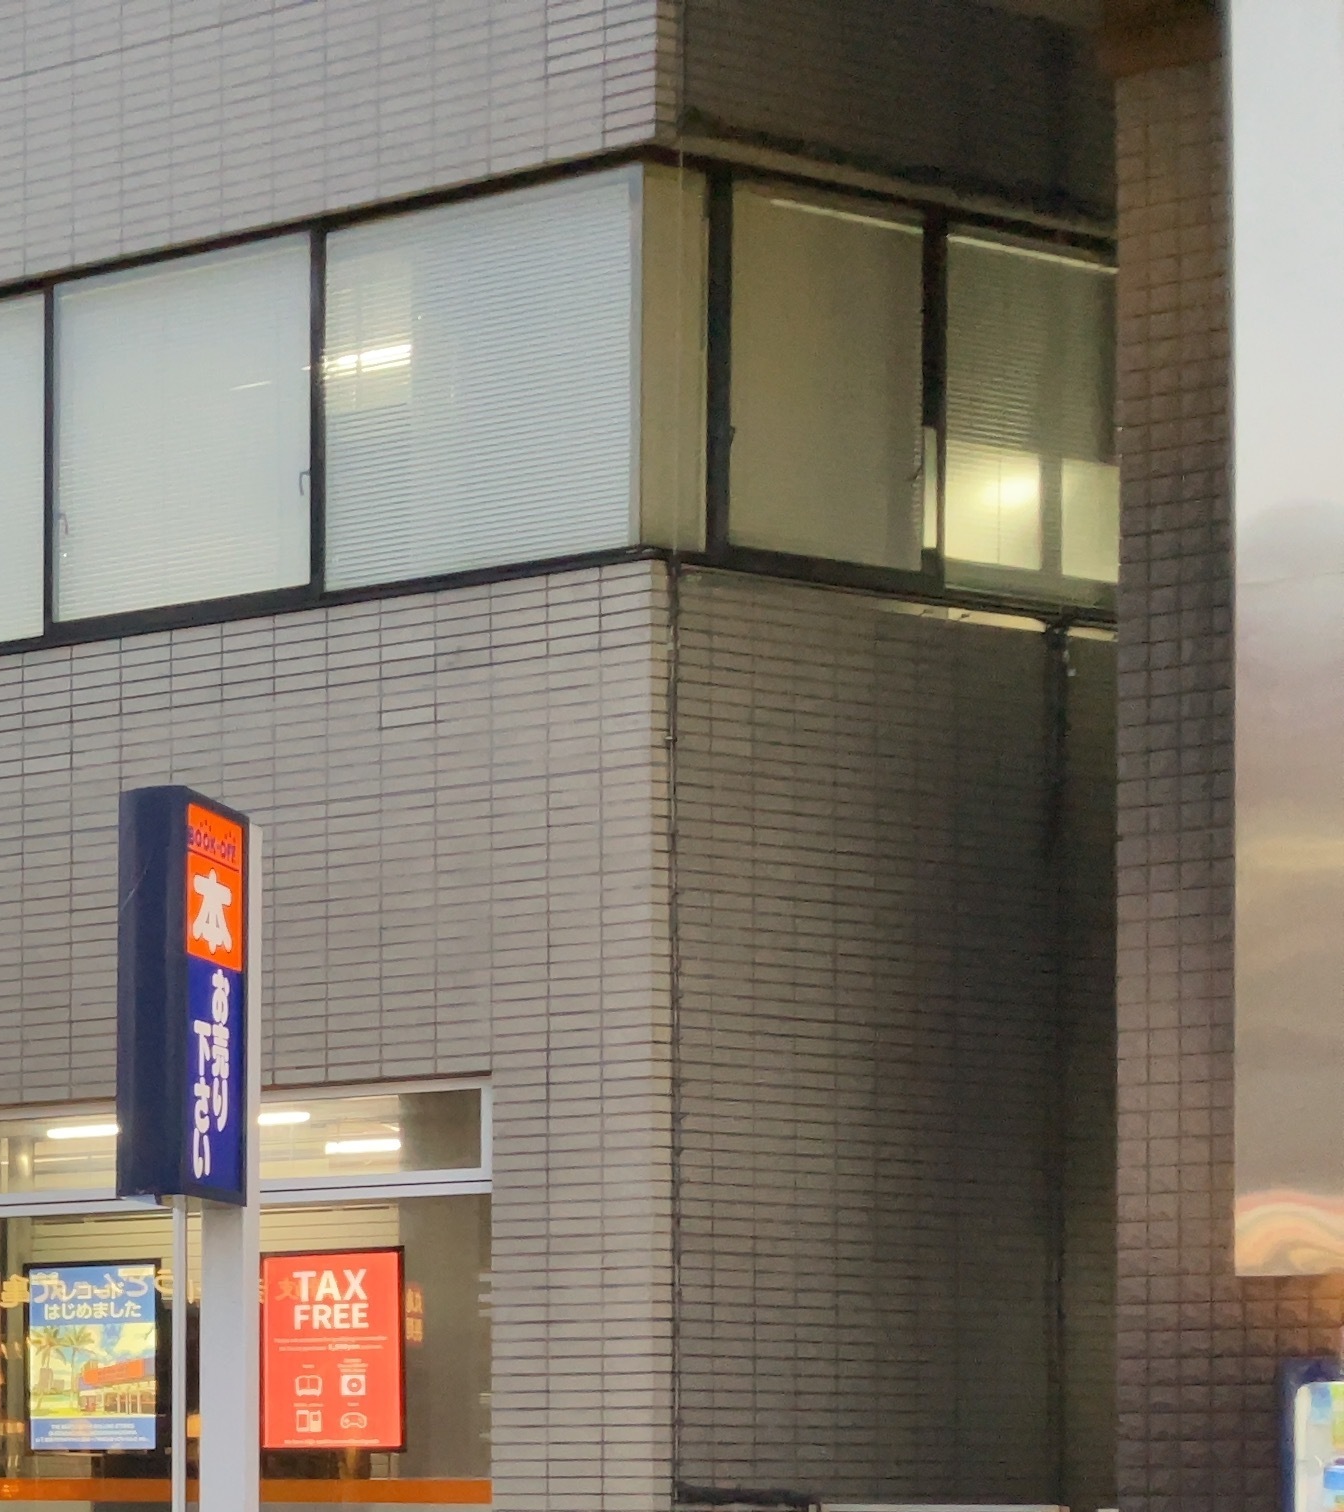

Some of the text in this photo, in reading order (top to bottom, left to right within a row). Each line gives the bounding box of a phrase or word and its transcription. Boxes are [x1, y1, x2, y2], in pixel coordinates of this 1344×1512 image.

[193, 868, 232, 955] 本
[212, 968, 230, 1132] お売り
[193, 1019, 211, 1179] 下さい
[44, 1300, 142, 1320] はじめました
[293, 1269, 367, 1302] TAX
[294, 1303, 369, 1330] FREE
